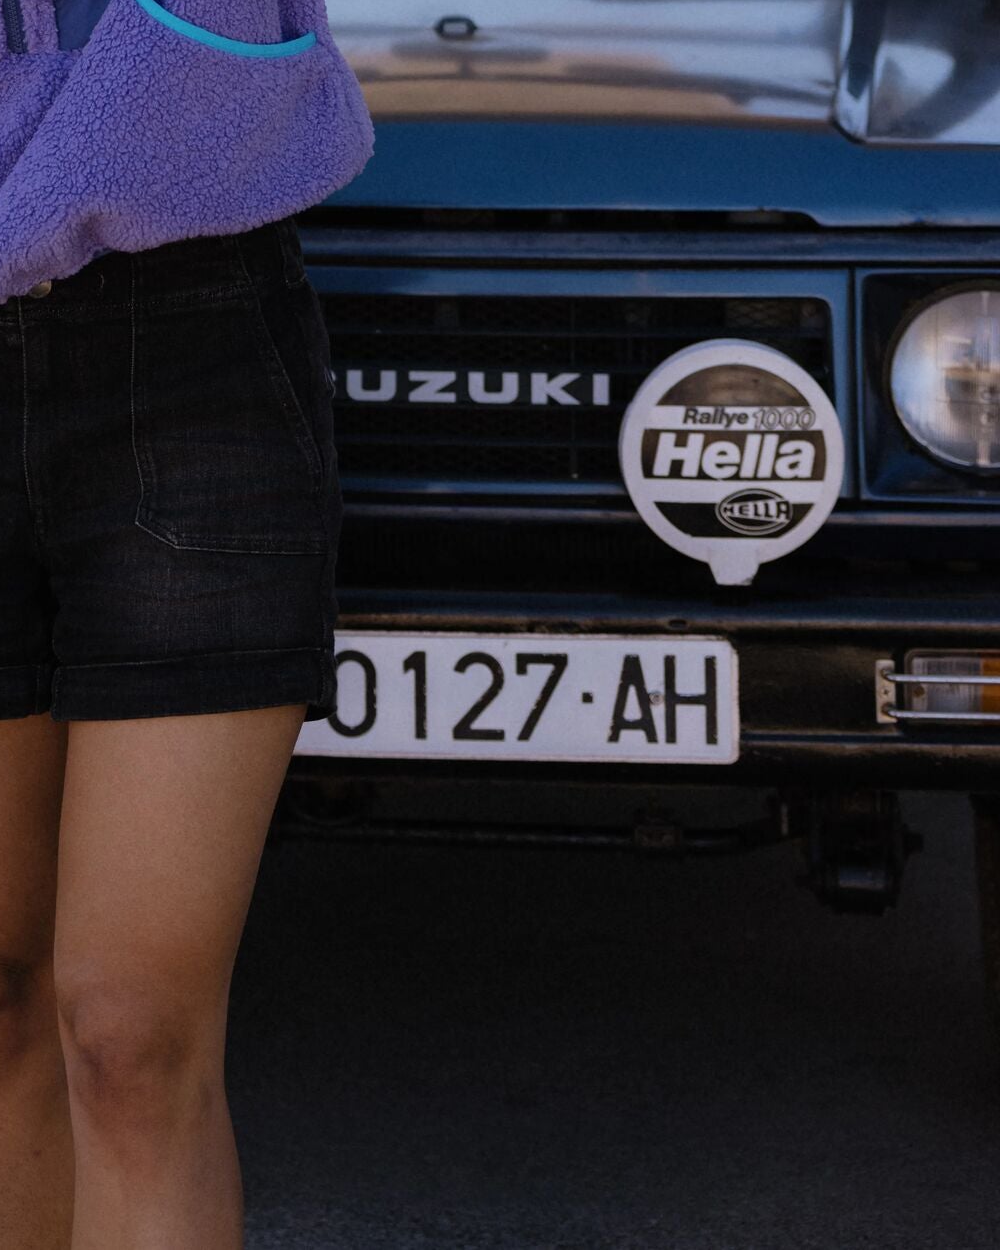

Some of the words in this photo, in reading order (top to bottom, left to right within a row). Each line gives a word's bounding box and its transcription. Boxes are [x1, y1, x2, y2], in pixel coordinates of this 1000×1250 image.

[330, 369, 610, 406] UZUKI
[683, 406, 749, 428] Rallye
[753, 405, 816, 430] 1000
[652, 432, 816, 480] Hella
[723, 500, 790, 520] HELLA
